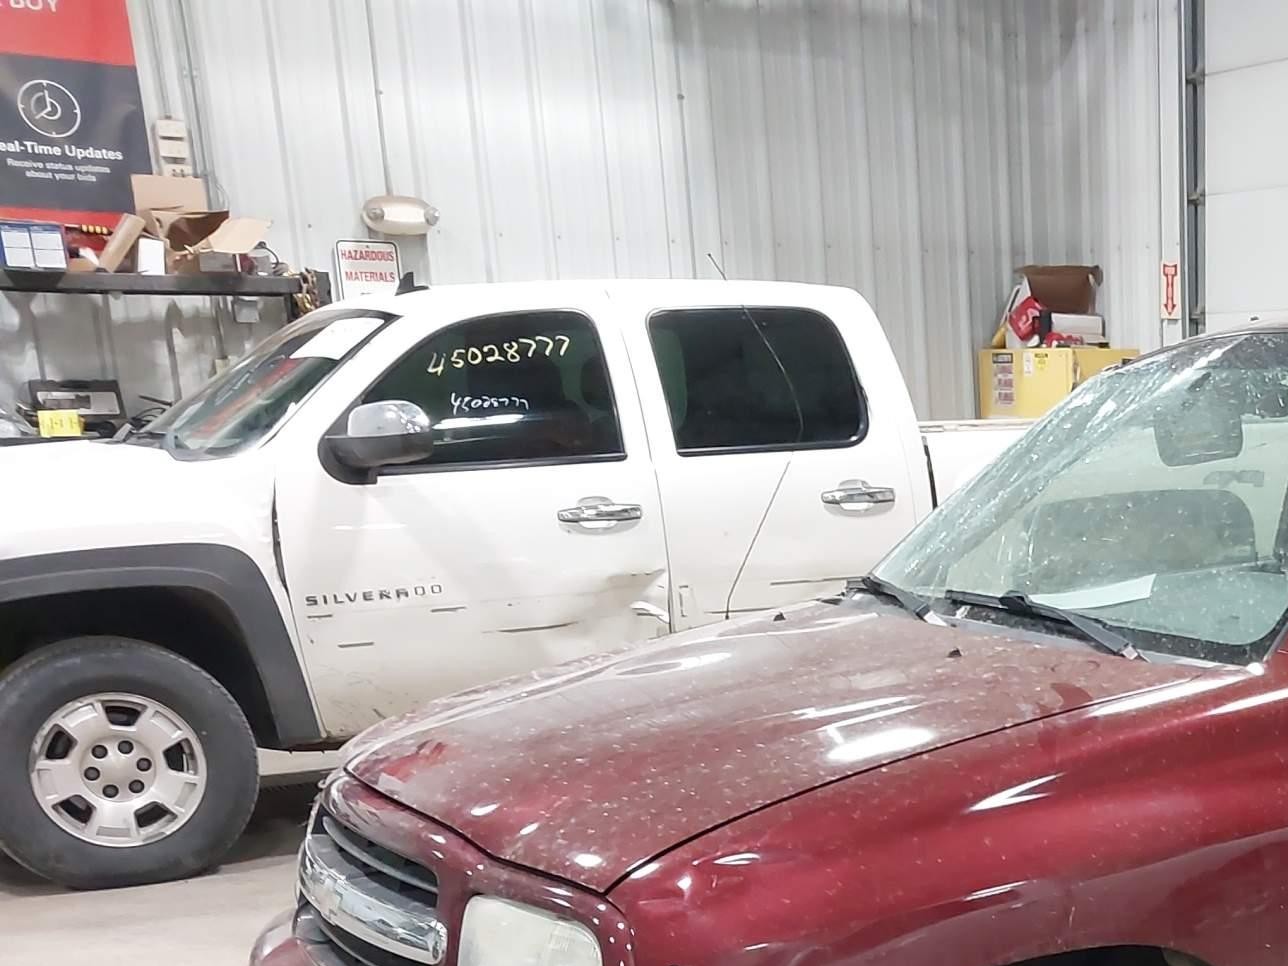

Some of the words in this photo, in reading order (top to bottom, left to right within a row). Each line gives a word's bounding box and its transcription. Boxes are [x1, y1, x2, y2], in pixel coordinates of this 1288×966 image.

[0, 140, 62, 156] eal-Time
[64, 145, 124, 160] Updates
[341, 249, 395, 262] HAZARDOUS
[345, 271, 396, 283] MATERIALS
[427, 335, 570, 377] 45028777
[304, 584, 443, 607] SILVERADO
